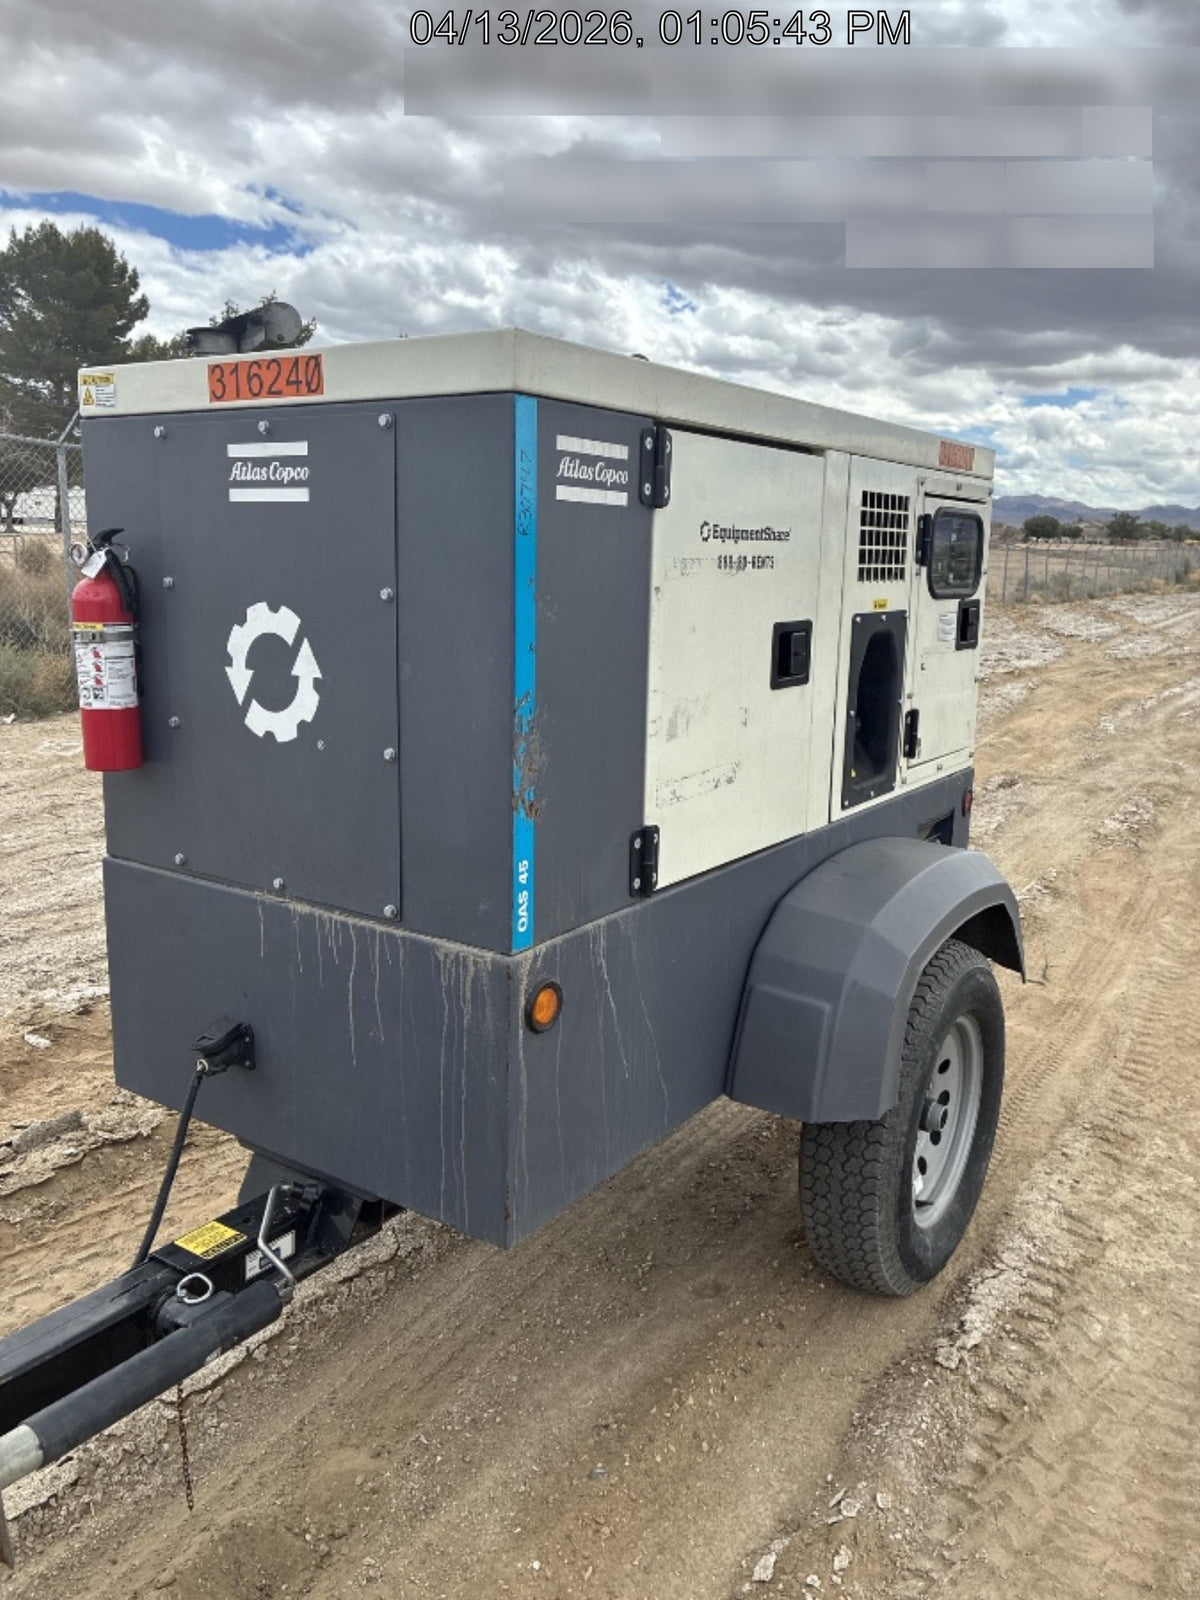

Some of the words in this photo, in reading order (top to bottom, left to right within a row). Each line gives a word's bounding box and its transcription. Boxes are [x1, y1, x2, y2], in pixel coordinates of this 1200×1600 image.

[210, 354, 322, 400] 316240
[228, 461, 269, 481] Atlas
[269, 461, 309, 484] Copco
[556, 456, 595, 481] Atlas
[595, 461, 629, 487] Copco
[712, 523, 791, 544] EquipmentShare
[518, 860, 529, 884] 45
[517, 890, 529, 932] QAS
